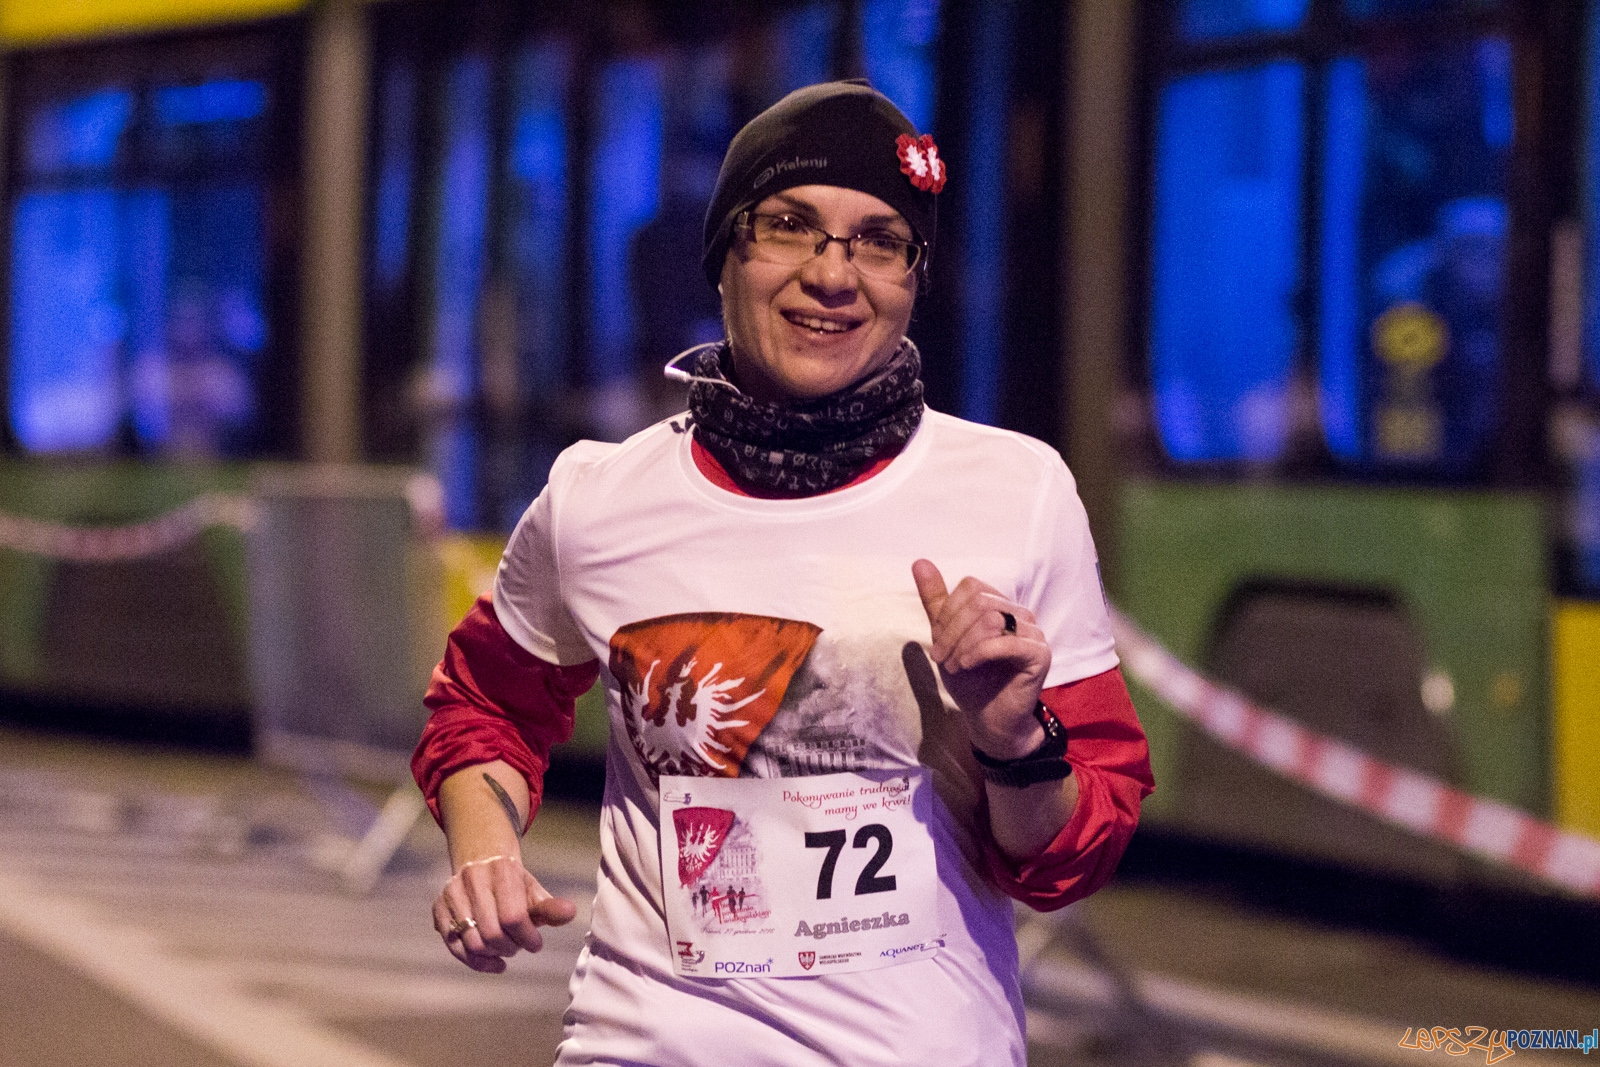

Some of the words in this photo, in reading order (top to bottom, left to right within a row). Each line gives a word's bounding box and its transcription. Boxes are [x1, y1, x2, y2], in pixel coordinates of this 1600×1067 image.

[782, 788, 855, 809] Pokonywanie
[825, 805, 858, 821] mamy
[862, 802, 877, 810] we
[881, 795, 911, 811] krwi!
[804, 823, 897, 900] 72
[794, 912, 910, 940] Agnieszka
